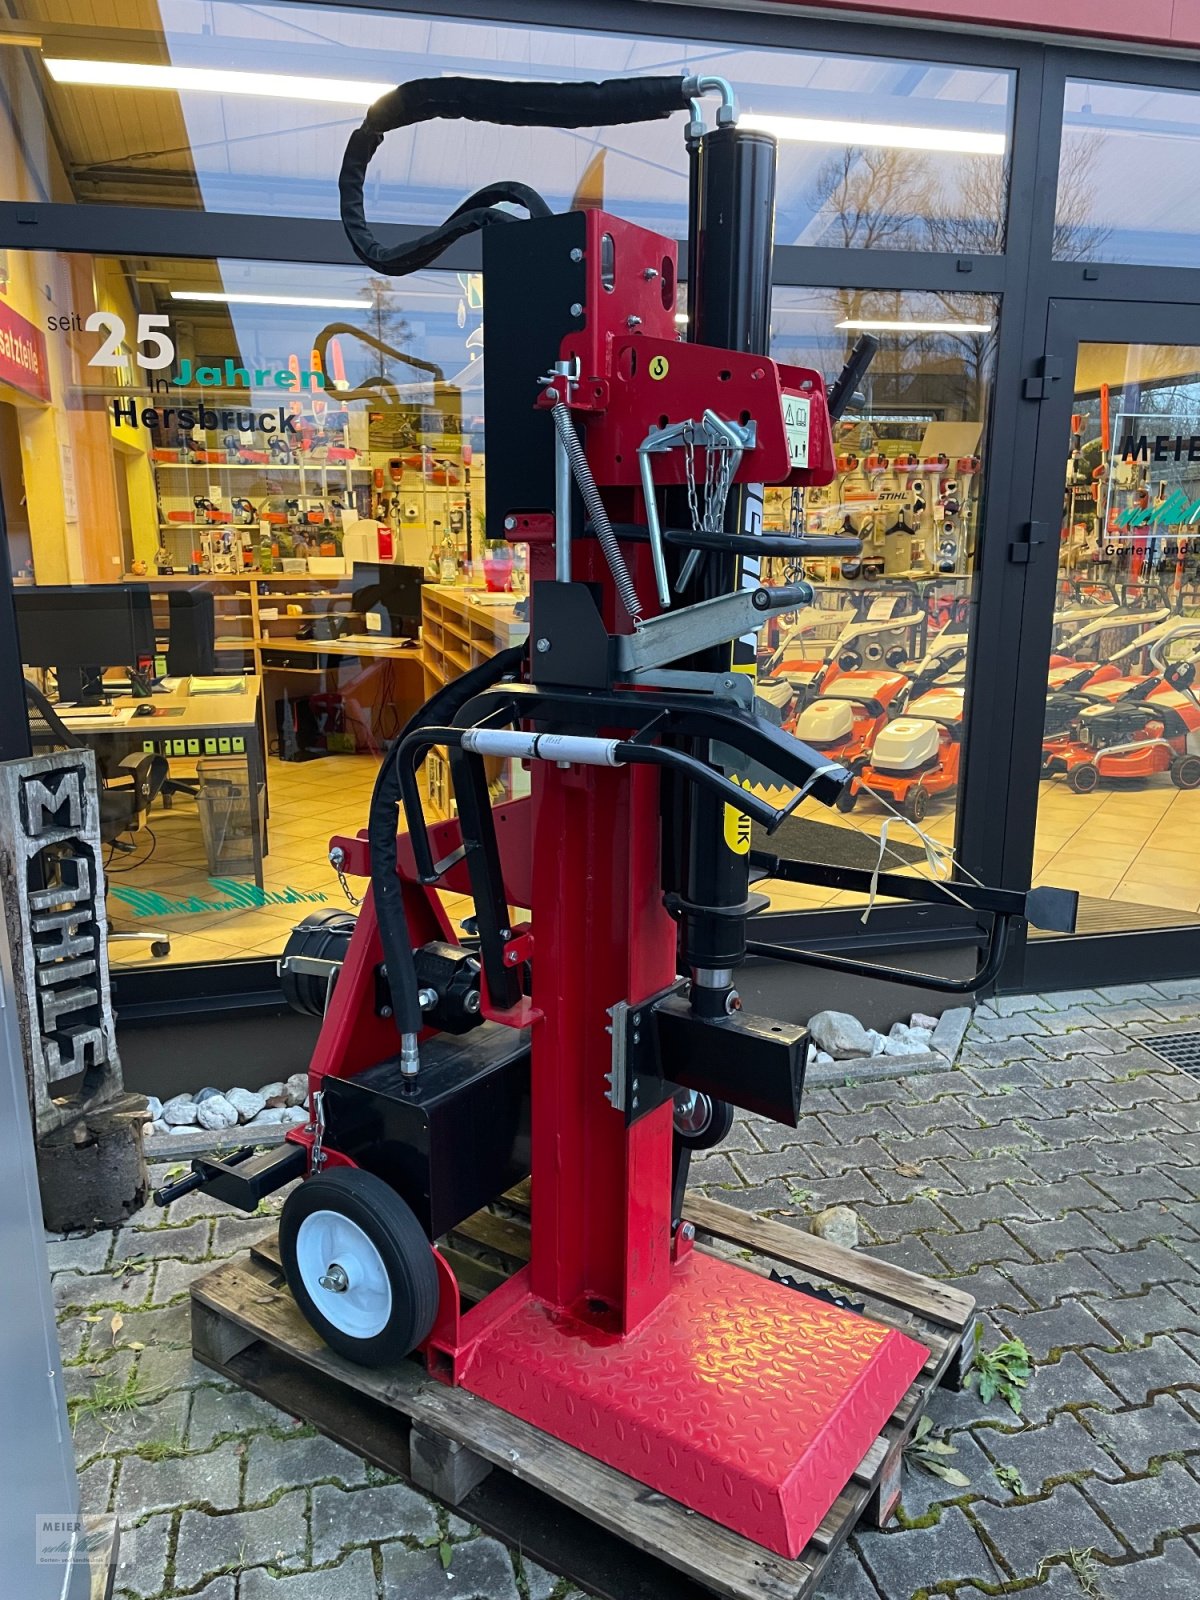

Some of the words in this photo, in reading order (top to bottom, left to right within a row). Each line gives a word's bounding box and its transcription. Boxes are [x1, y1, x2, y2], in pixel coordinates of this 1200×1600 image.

[47, 313, 83, 332] seit
[85, 311, 175, 370] 25
[172, 358, 325, 388] Jahren
[150, 375, 169, 394] in
[112, 399, 298, 435] Hersbruck
[878, 492, 907, 501] STIHL
[1105, 545, 1157, 556] Garten-
[1164, 544, 1188, 554] und
[28, 856, 107, 1083] STIHL
